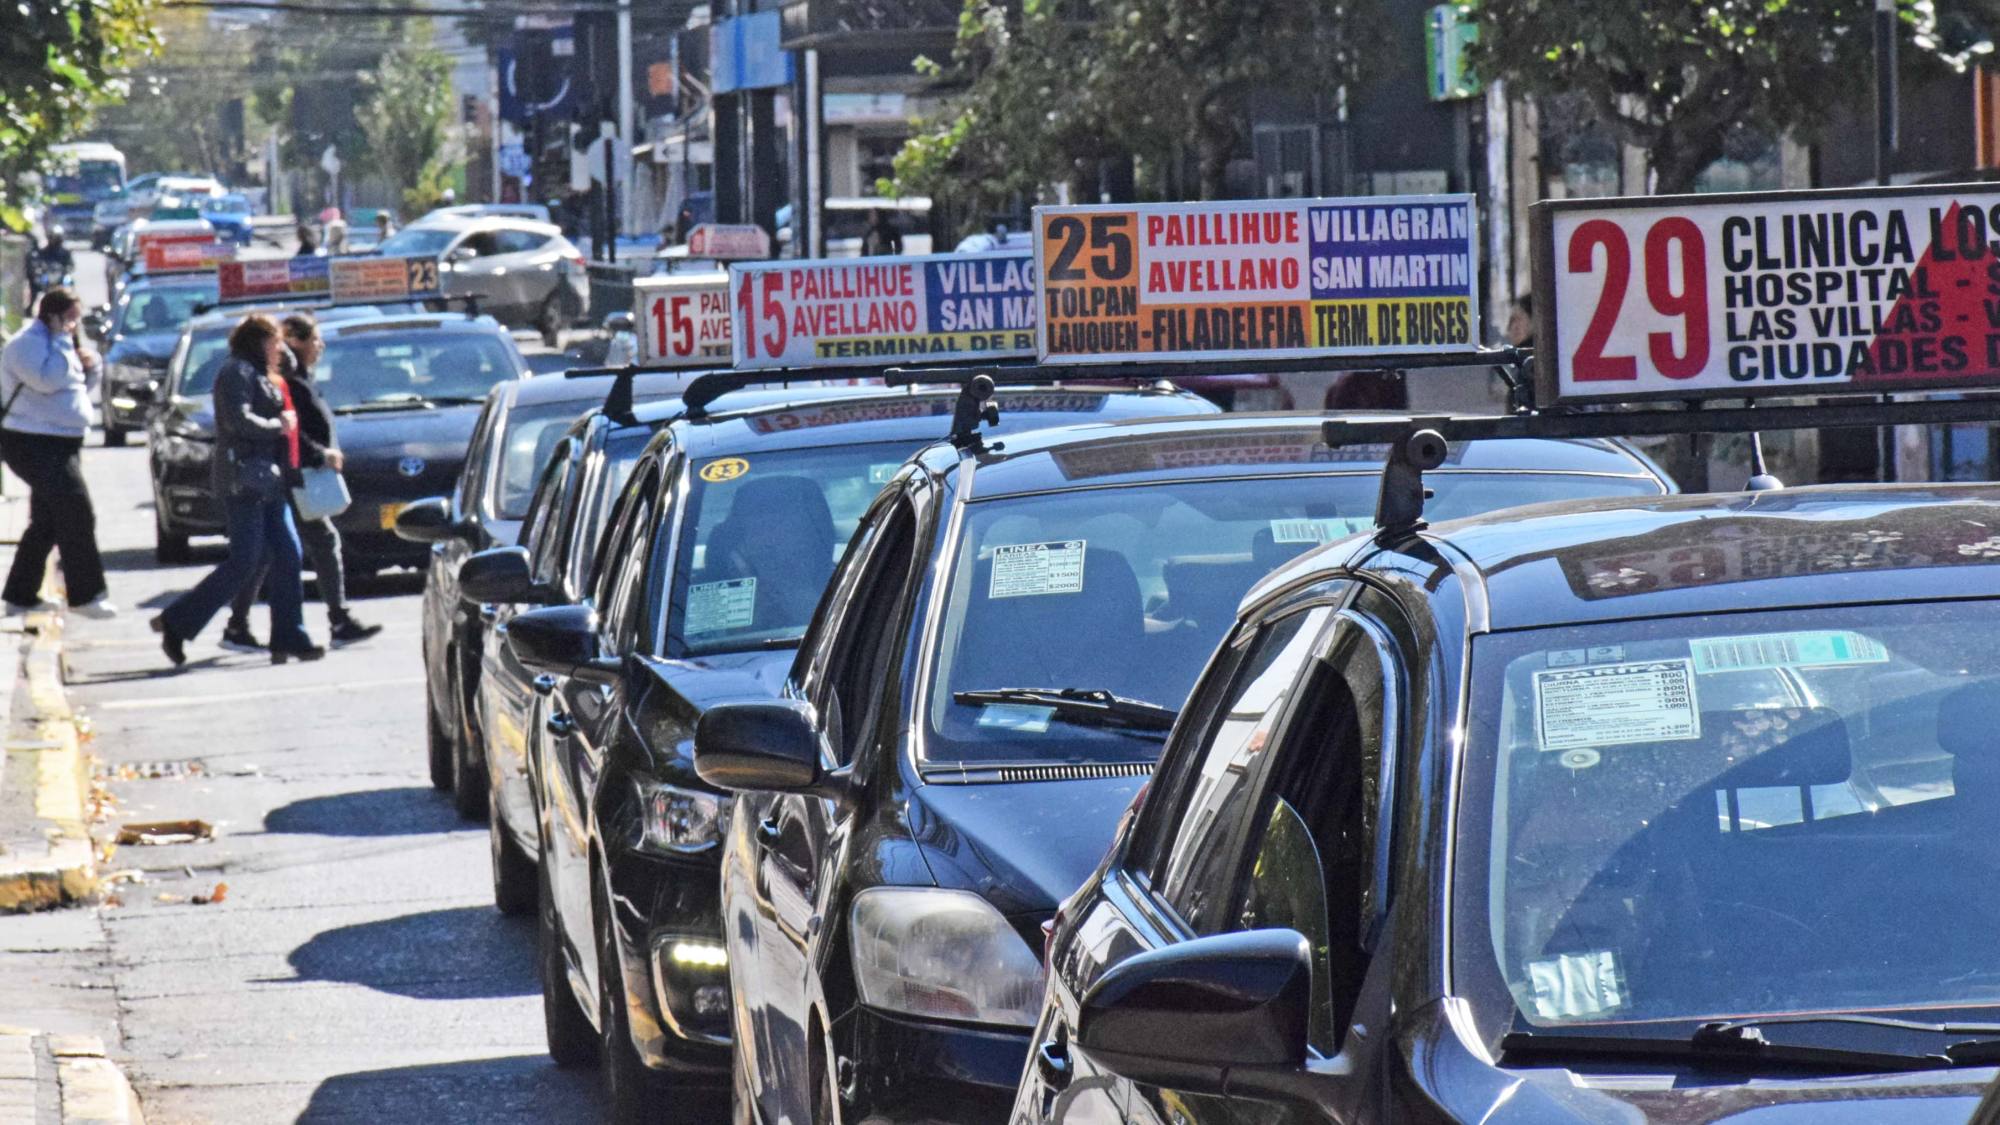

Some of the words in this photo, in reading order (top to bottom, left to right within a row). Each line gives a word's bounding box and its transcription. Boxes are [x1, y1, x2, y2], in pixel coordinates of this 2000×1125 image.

[1147, 210, 1300, 248] PAILLIHUE
[1310, 207, 1468, 243] VILLAGRAN
[1722, 209, 1914, 272] CLINICA
[1047, 215, 1134, 282] 25
[411, 262, 437, 290] 23
[791, 263, 914, 301] PAILLIHUE
[1147, 256, 1300, 294] AVELLANO
[1312, 256, 1364, 290] SAN
[1369, 252, 1468, 289] MARTIN
[1724, 267, 1940, 308] HOSPITAL
[738, 271, 787, 360] 15
[940, 300, 996, 333] SAN
[1045, 285, 1137, 319] TOLPAN
[1568, 216, 1711, 382] 29
[652, 296, 694, 358] 15
[792, 301, 917, 338] AVELLANO
[1315, 304, 1374, 347] TERM.
[1378, 302, 1402, 345] DE
[1405, 301, 1469, 346] BUSES
[1726, 307, 1798, 342] LAS
[1811, 302, 1942, 338] VILLAS
[817, 336, 967, 359] TERMINAL
[970, 334, 1006, 353] DE
[1727, 335, 1968, 382] CIUDADES
[1000, 543, 1049, 554] LINEA
[1550, 664, 1670, 680] TARIFA
